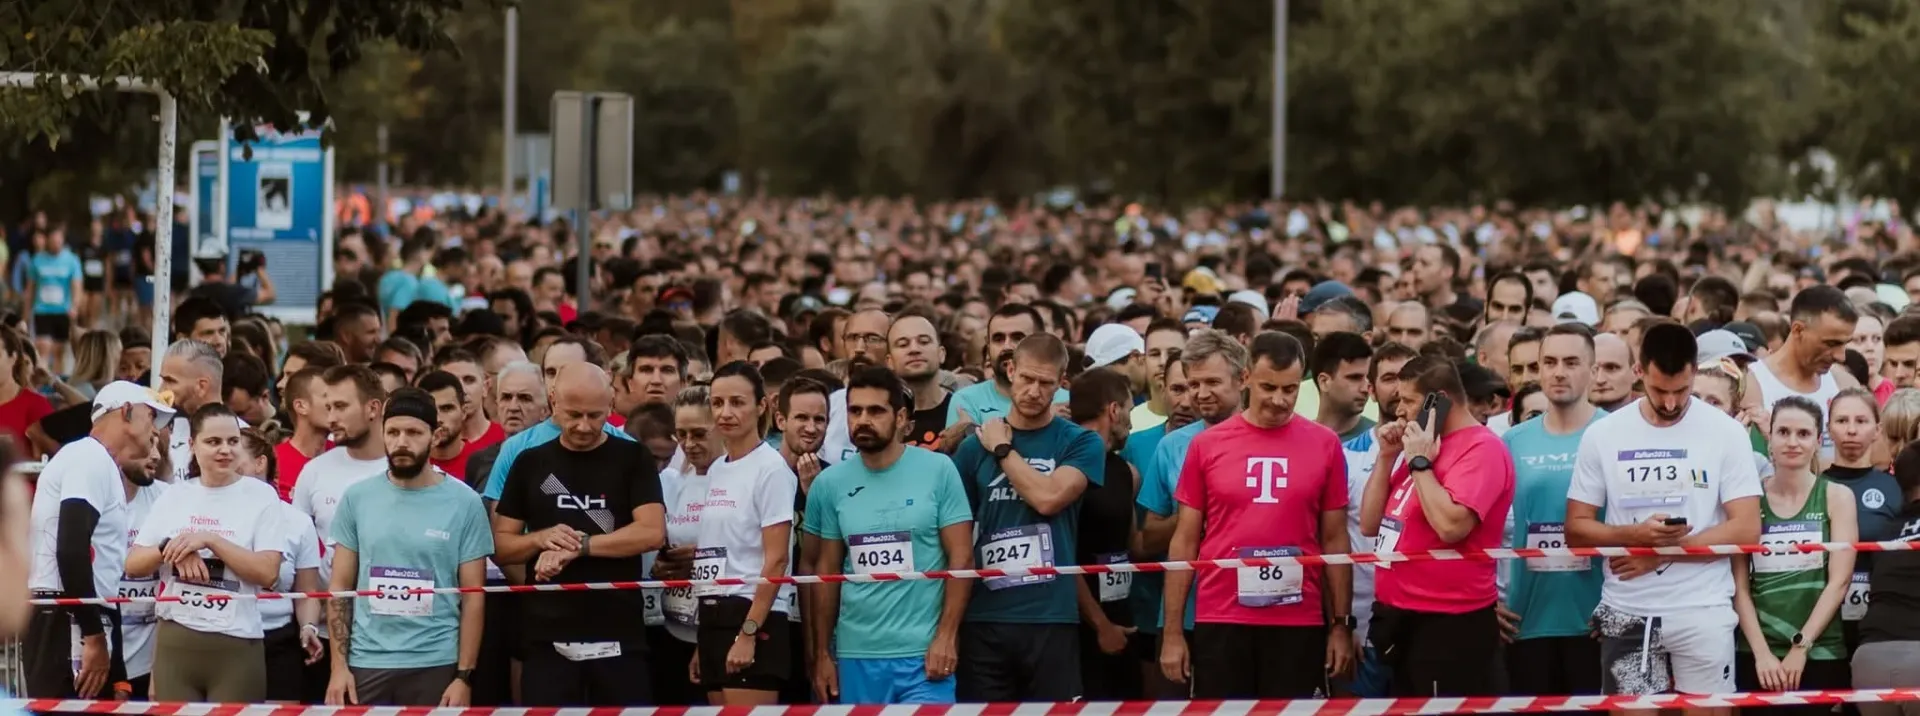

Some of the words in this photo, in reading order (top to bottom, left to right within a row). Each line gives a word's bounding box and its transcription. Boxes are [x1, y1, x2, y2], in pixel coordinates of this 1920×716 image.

[1246, 457, 1288, 503] T
[1627, 465, 1677, 482] 1713
[988, 487, 1024, 501] ALT
[858, 549, 904, 567] 4034
[986, 543, 1031, 565] 2247
[1259, 566, 1283, 581] 86
